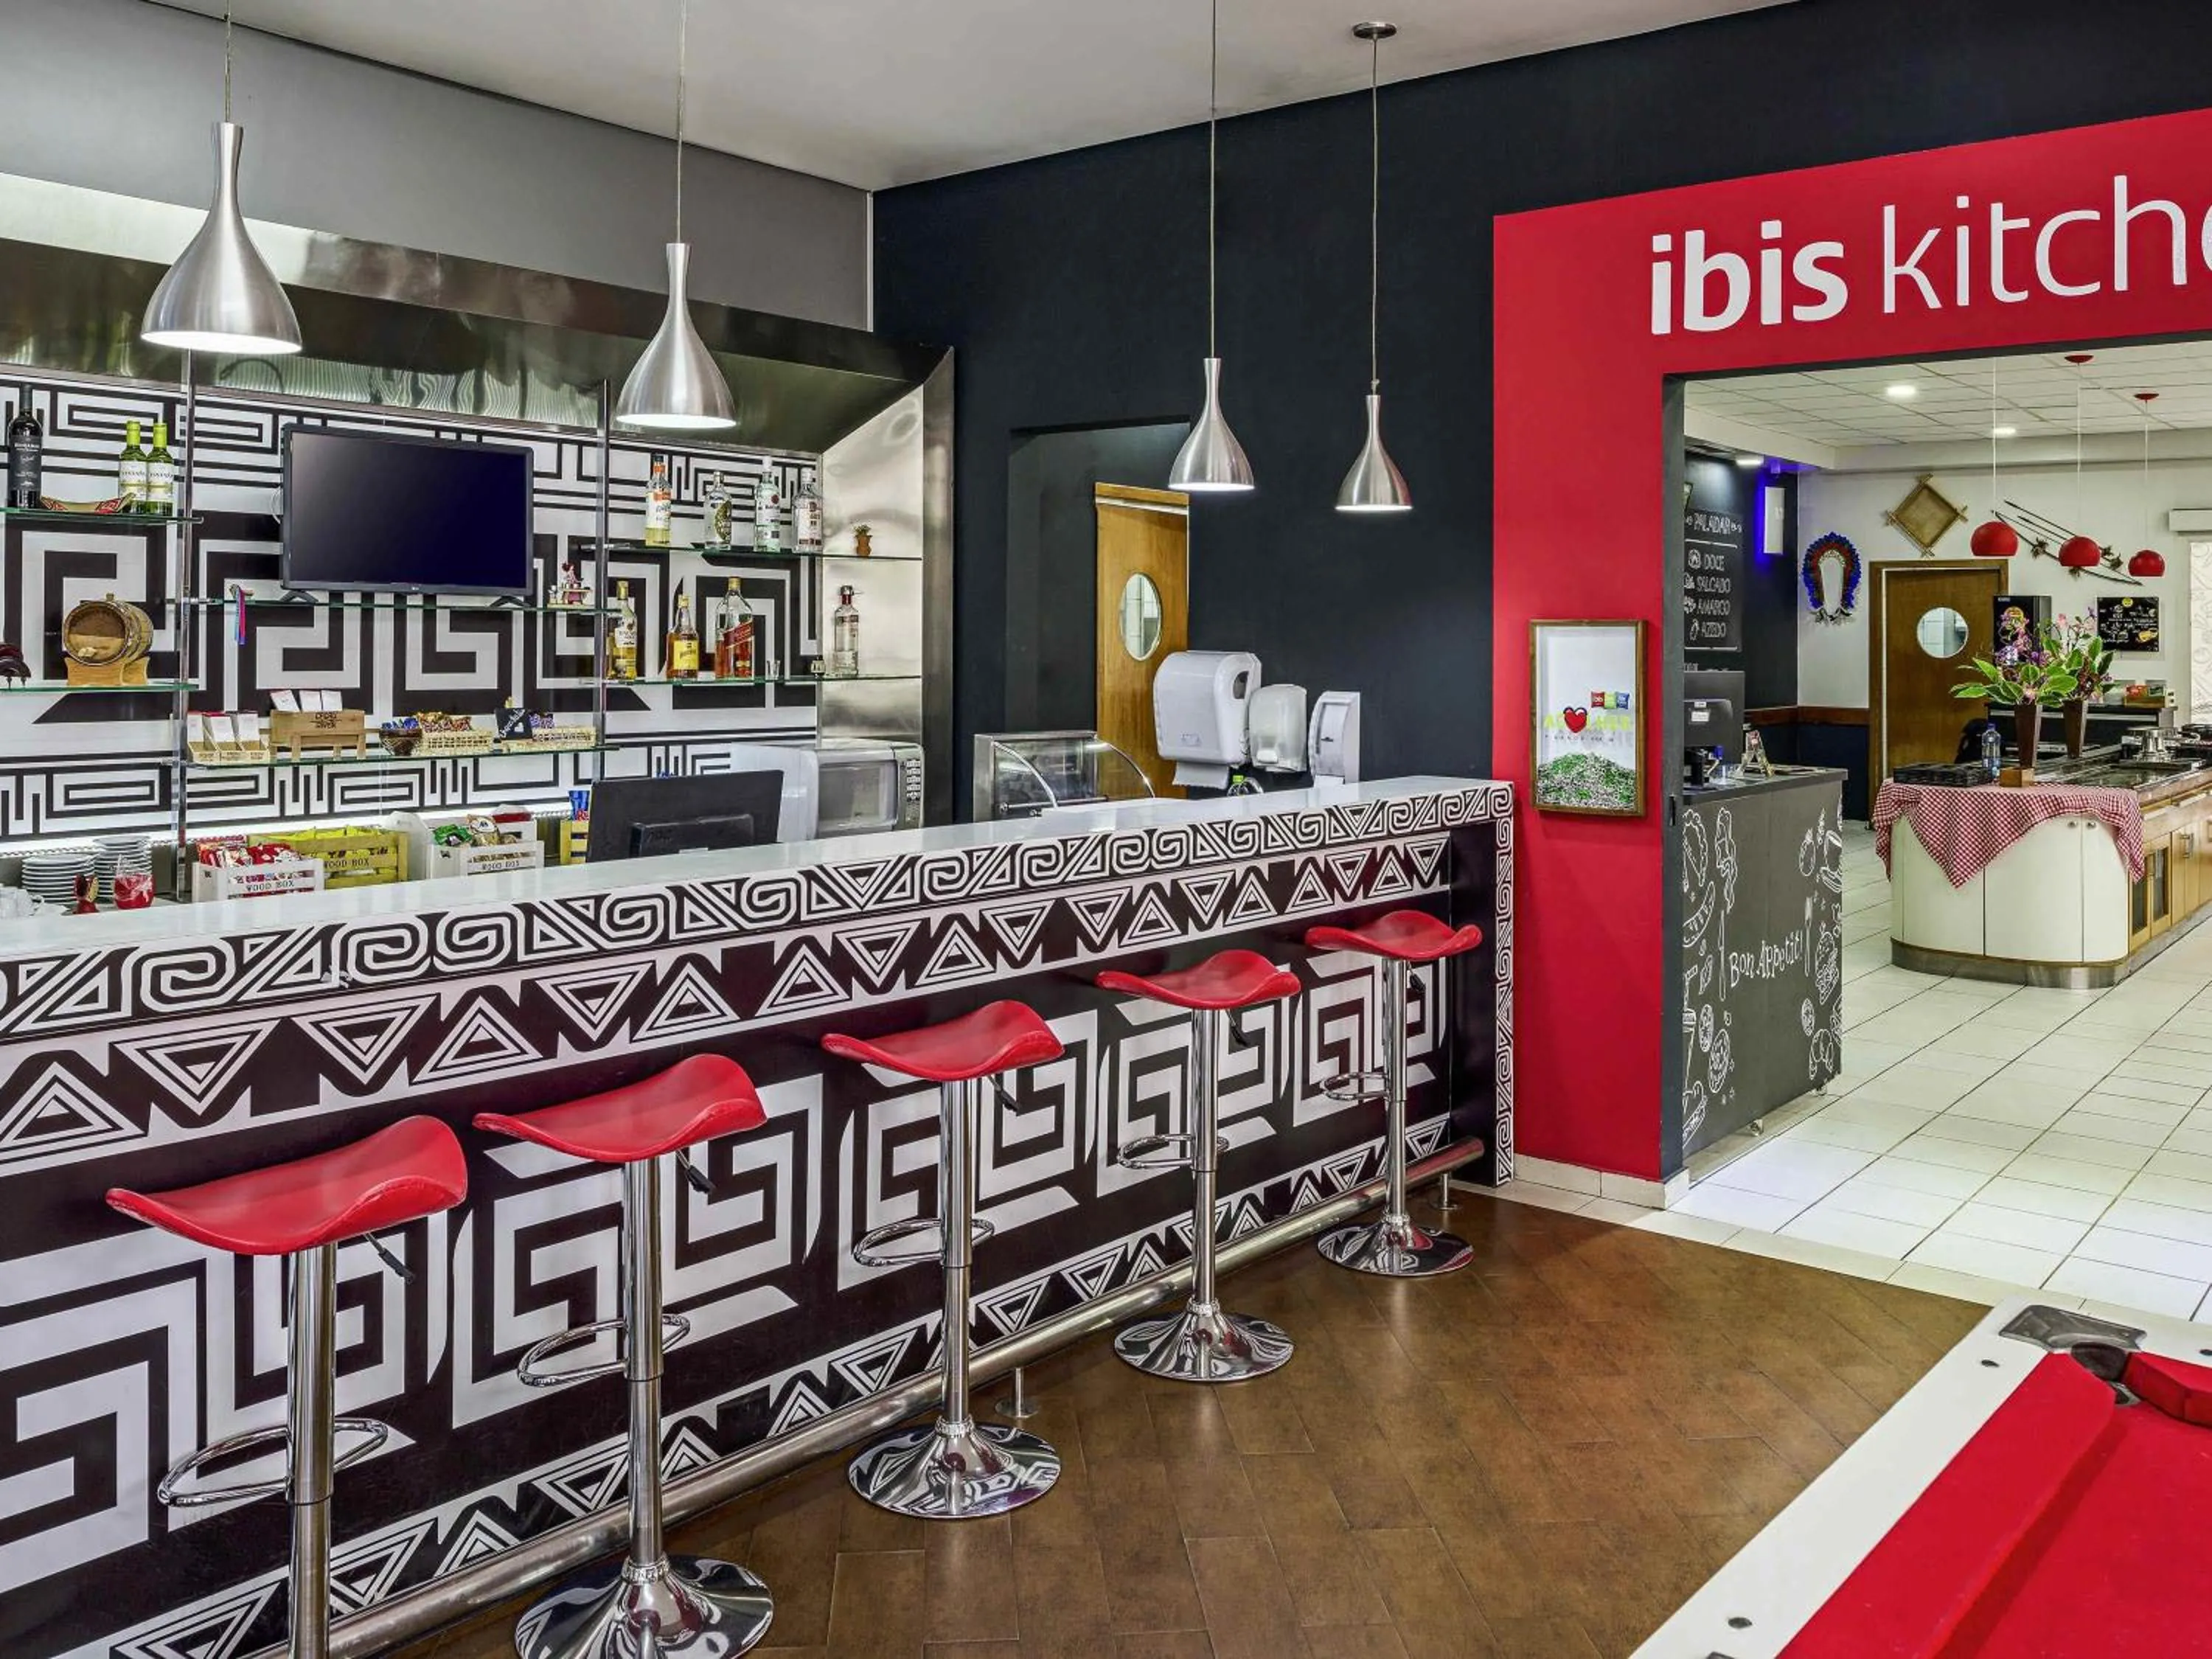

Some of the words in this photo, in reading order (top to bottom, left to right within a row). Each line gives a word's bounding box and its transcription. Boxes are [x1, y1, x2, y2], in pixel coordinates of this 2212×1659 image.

[1651, 219, 1848, 335] ibis
[1883, 174, 2212, 314] kitch
[1728, 952, 1754, 988] Bon
